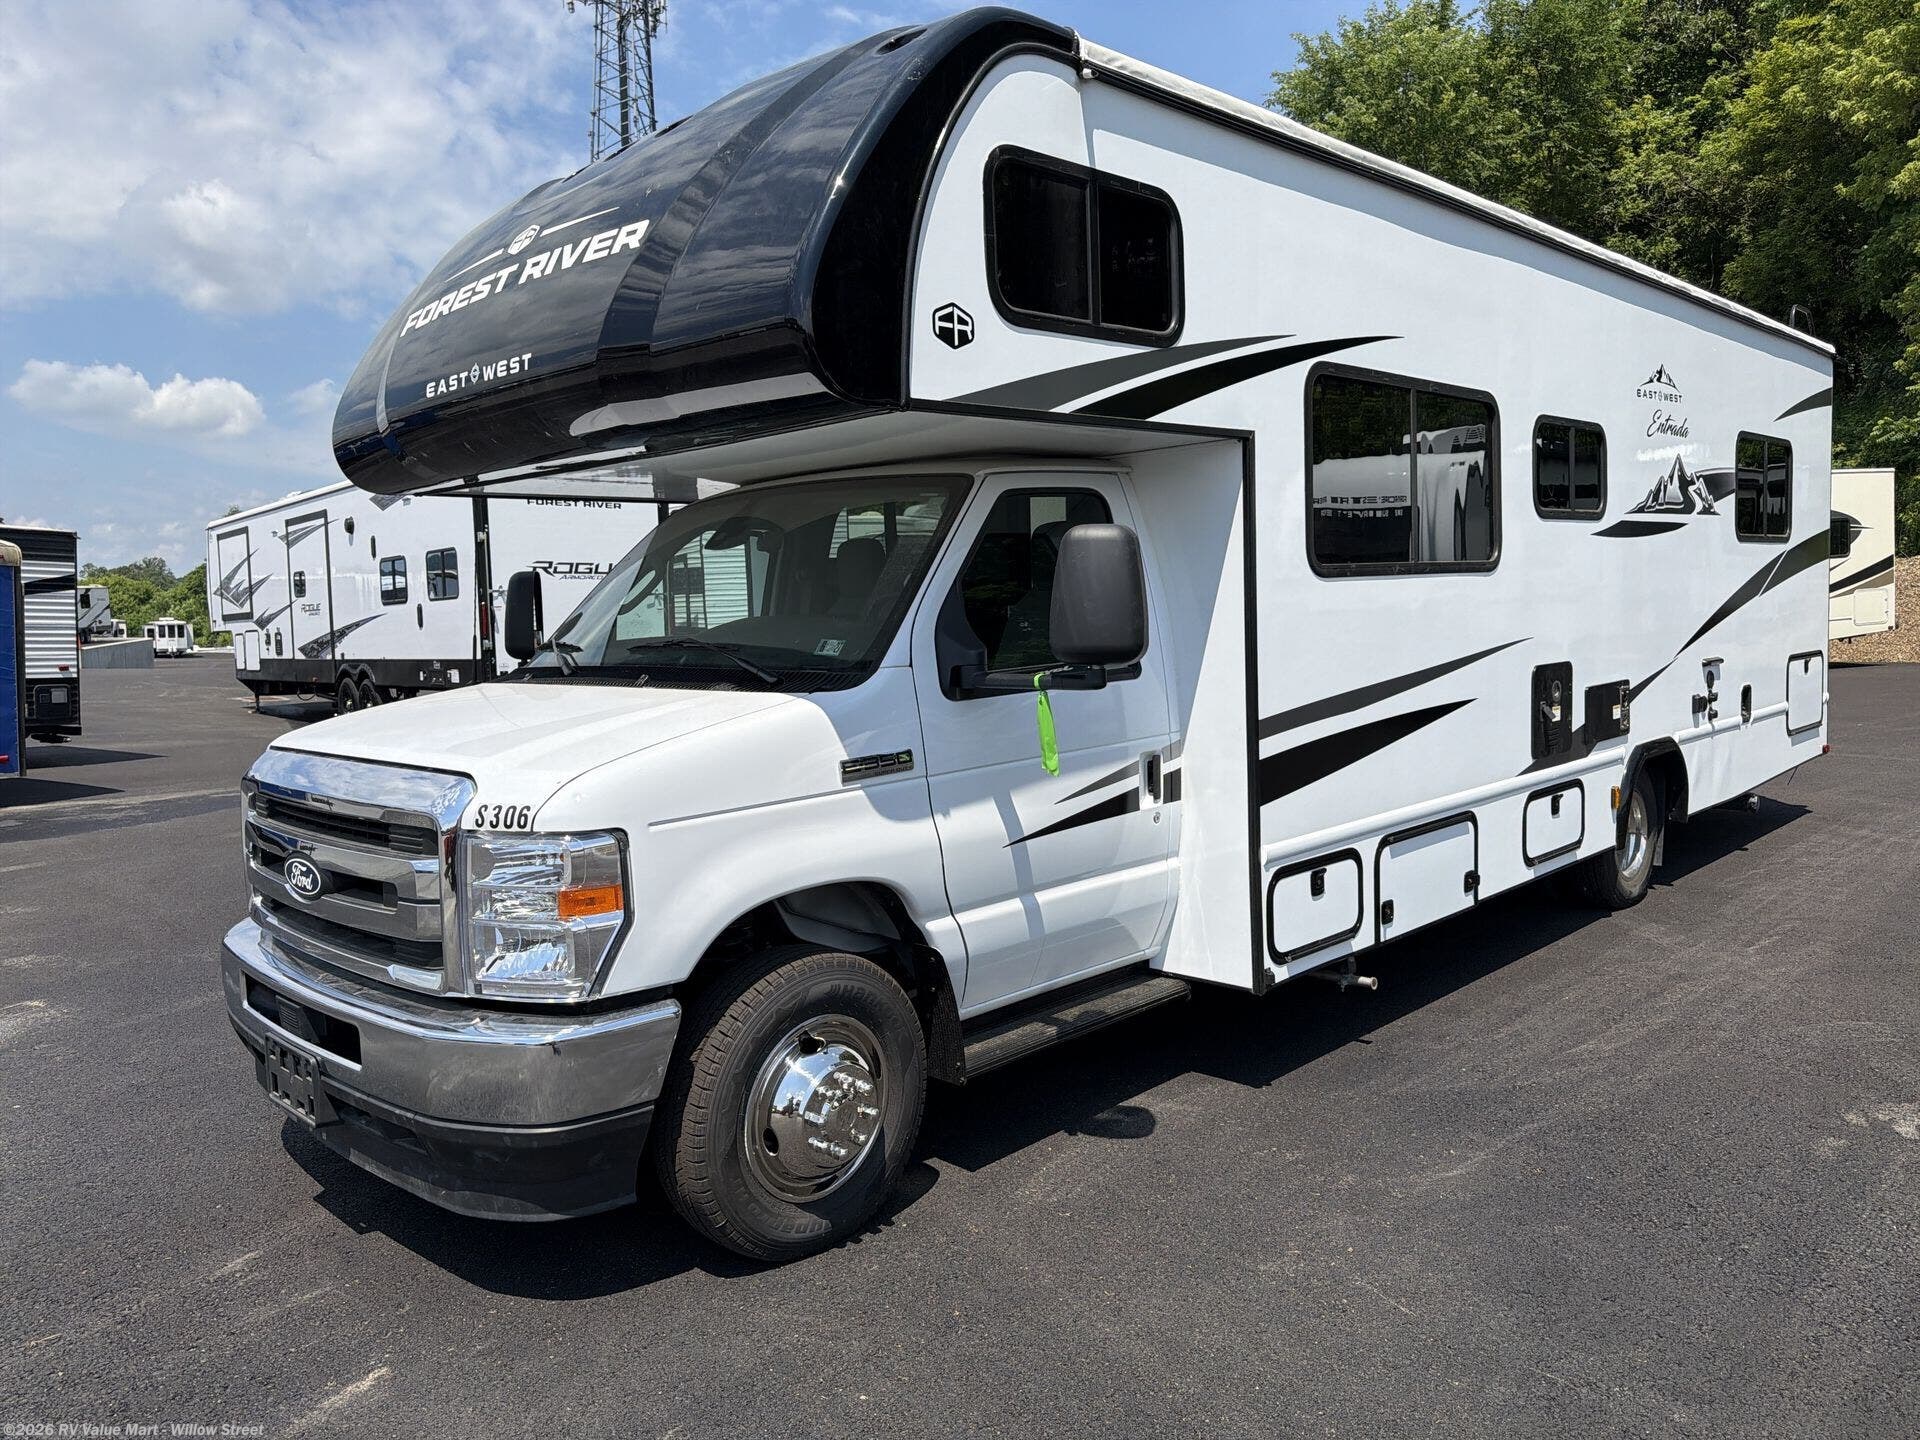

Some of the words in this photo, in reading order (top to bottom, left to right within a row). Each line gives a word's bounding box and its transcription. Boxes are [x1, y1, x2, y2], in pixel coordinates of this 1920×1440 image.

[400, 263, 519, 338] FOREST
[518, 219, 650, 285] RIVER
[426, 371, 469, 398] EAST
[483, 353, 532, 381] WEST
[1636, 388, 1658, 400] EAST
[1663, 393, 1683, 403] WEST
[1646, 409, 1689, 438] Entrada
[583, 501, 622, 509] RIVER
[526, 560, 614, 577] ROGU
[475, 804, 531, 829] S306
[291, 857, 313, 891] Ford
